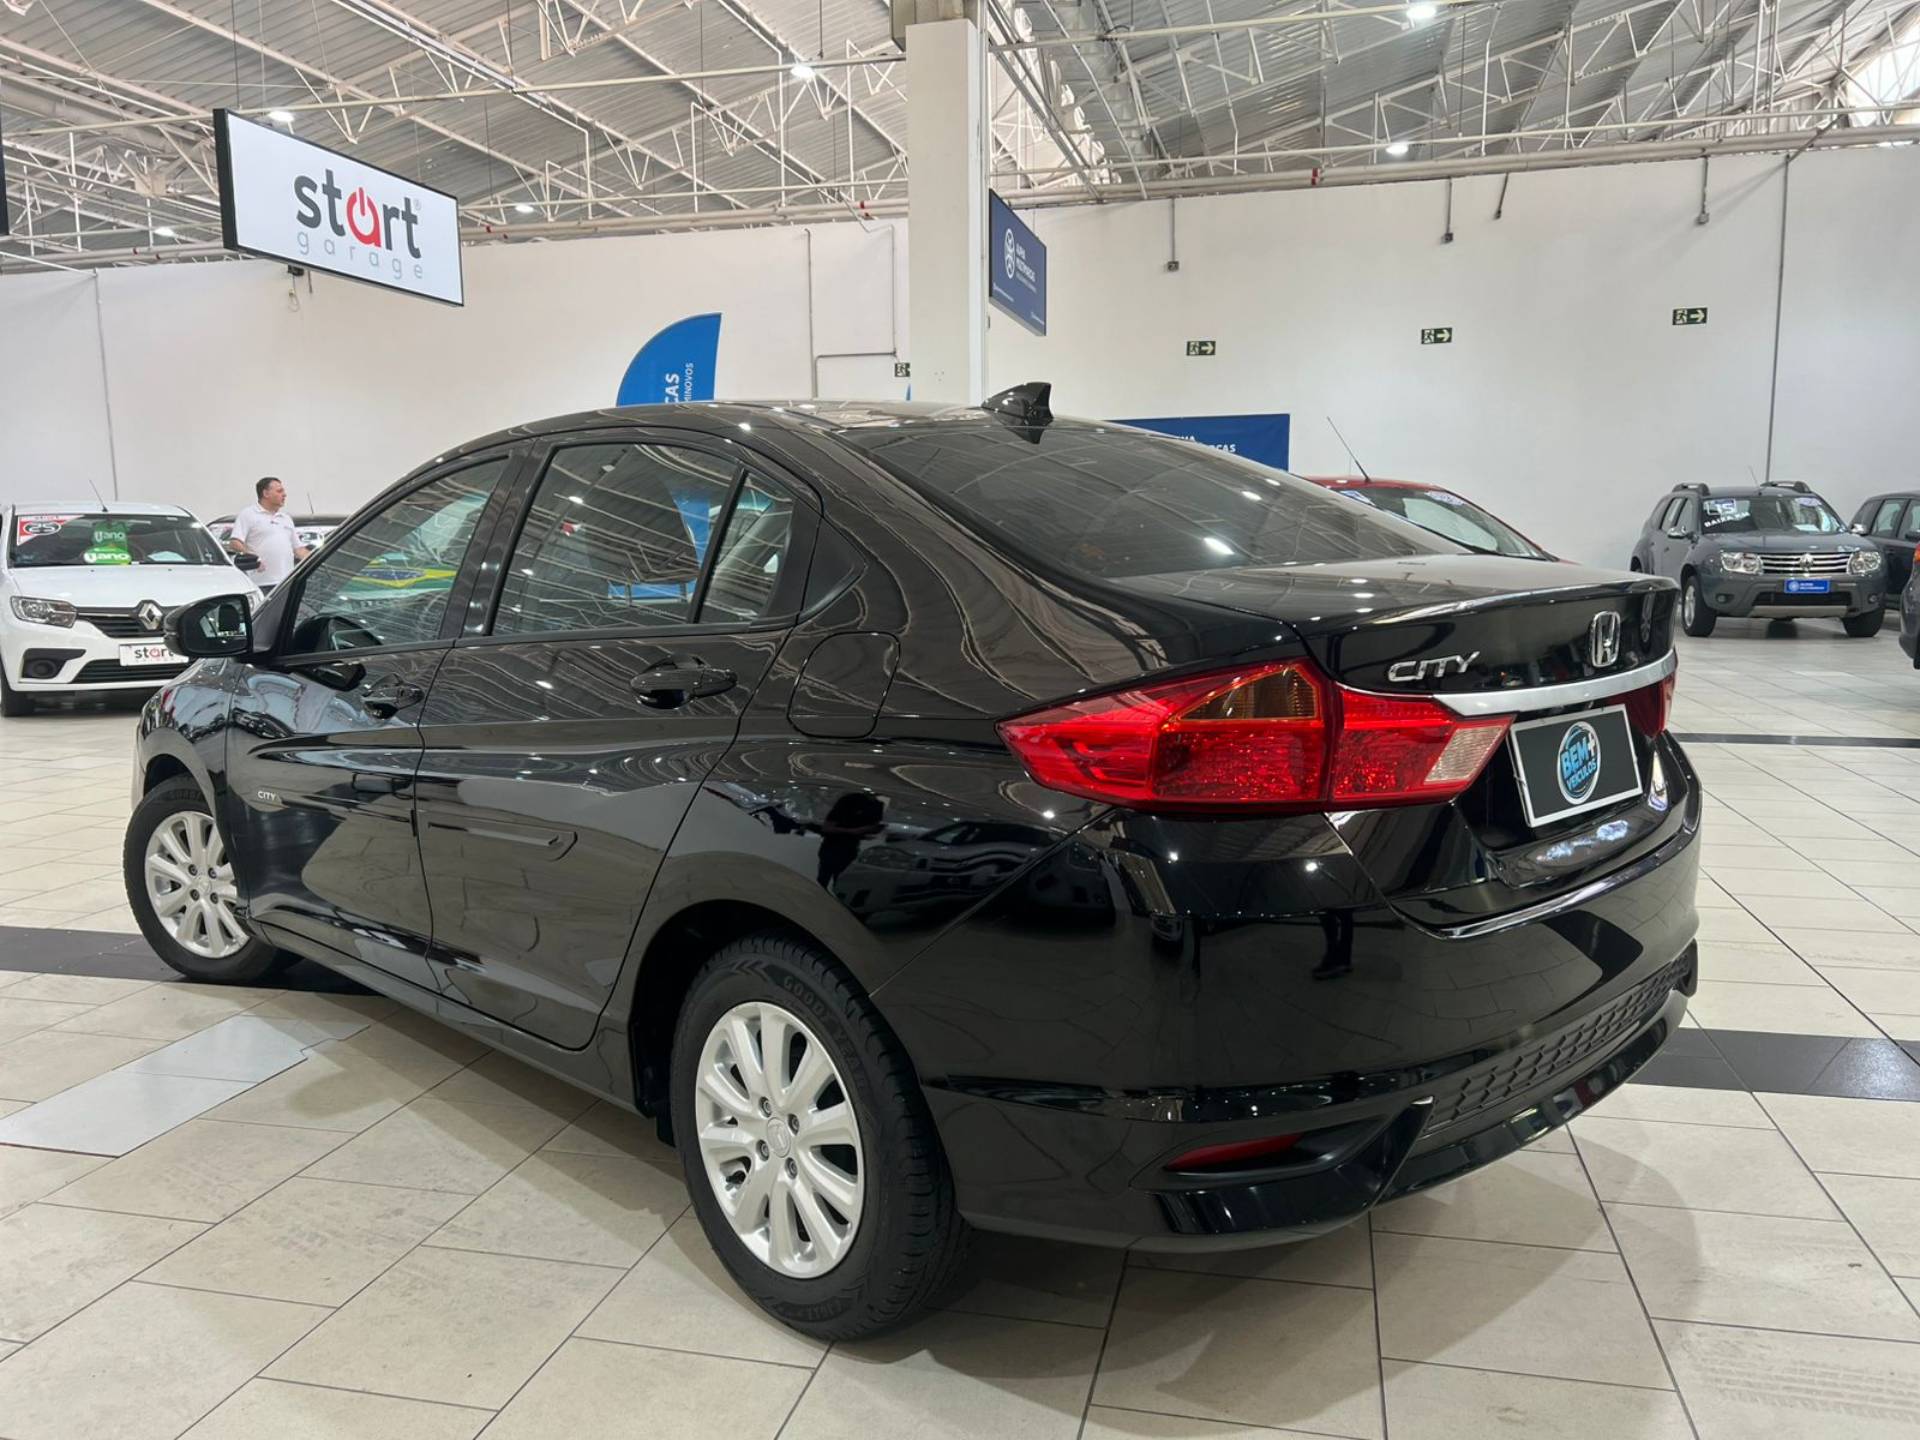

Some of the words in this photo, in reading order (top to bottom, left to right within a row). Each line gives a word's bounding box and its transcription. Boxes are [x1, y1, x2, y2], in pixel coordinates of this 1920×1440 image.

[294, 168, 421, 259] start
[297, 231, 423, 280] garage
[1387, 651, 1480, 682] CITY
[257, 790, 277, 801] CITY
